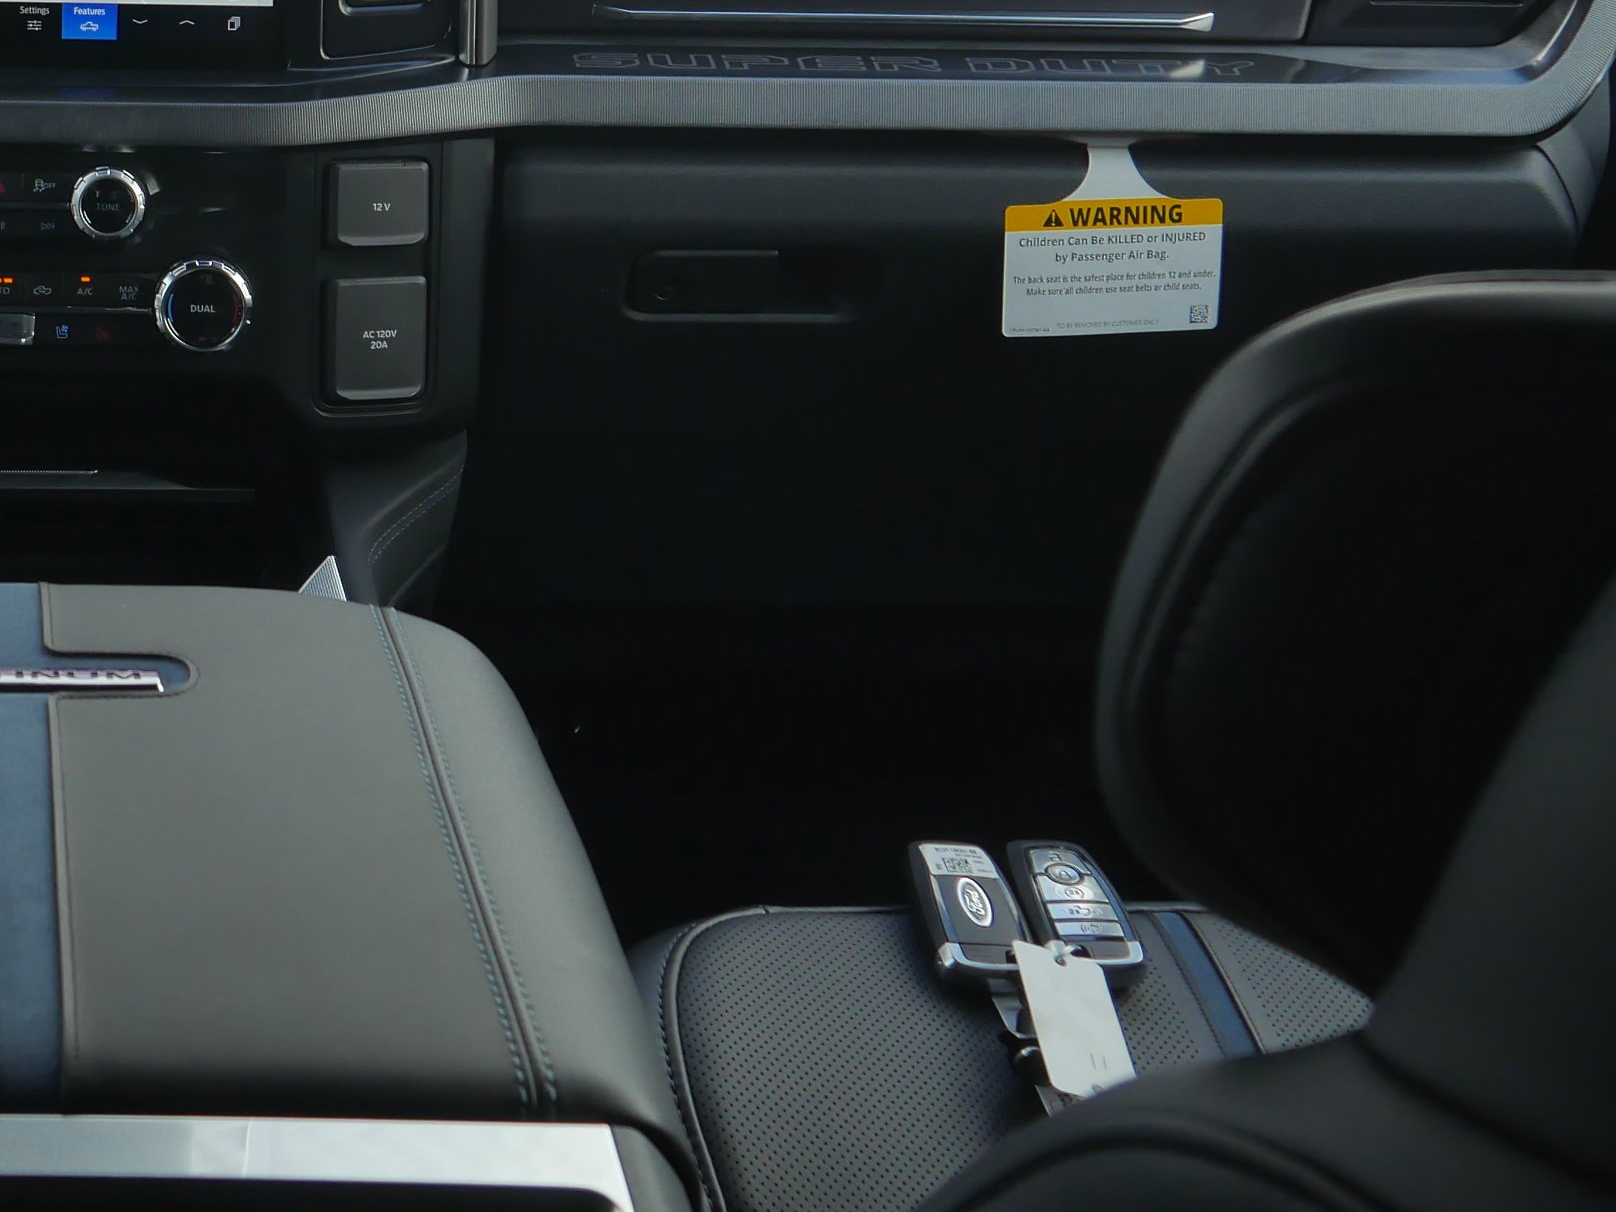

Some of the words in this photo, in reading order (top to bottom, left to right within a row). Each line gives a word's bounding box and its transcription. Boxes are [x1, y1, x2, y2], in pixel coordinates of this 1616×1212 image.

[19, 6, 50, 16] Settings
[73, 6, 106, 16] Features
[572, 52, 942, 72] SUPER
[965, 56, 1255, 76] DUTY
[372, 202, 383, 212] 12
[384, 202, 391, 212] V
[1069, 203, 1184, 228] WARNING
[1019, 236, 1065, 248] Children
[1067, 236, 1088, 247] Can
[1091, 235, 1105, 246] Be
[1108, 234, 1144, 245] KILLED
[1147, 235, 1158, 244] or
[1161, 231, 1207, 245] INJURED
[1055, 252, 1069, 264] by
[1071, 251, 1125, 264] Passenger
[1128, 250, 1144, 260] Air
[1147, 249, 1170, 262] Bag.
[1012, 275, 1026, 284] The
[1027, 275, 1044, 284] back
[1046, 275, 1061, 284] seat
[1062, 275, 1068, 283] is
[1070, 274, 1082, 283] the
[1084, 273, 1105, 282] safest
[1106, 272, 1125, 283] place
[1126, 272, 1137, 281] for
[1138, 271, 1166, 280] children
[1168, 270, 1177, 279] 12
[1178, 270, 1192, 279] and
[77, 287, 94, 296] A/C
[119, 285, 139, 294] MAX
[1026, 288, 1046, 296] Make
[1048, 288, 1062, 296] sure
[1064, 286, 1073, 295] all
[1075, 286, 1104, 295] children
[1119, 285, 1134, 293] seat
[1135, 283, 1153, 292] belts
[1163, 282, 1181, 291] child
[190, 304, 216, 314] DUAL
[362, 330, 375, 339] AC
[376, 329, 398, 339] 120V
[370, 340, 389, 350] 20A
